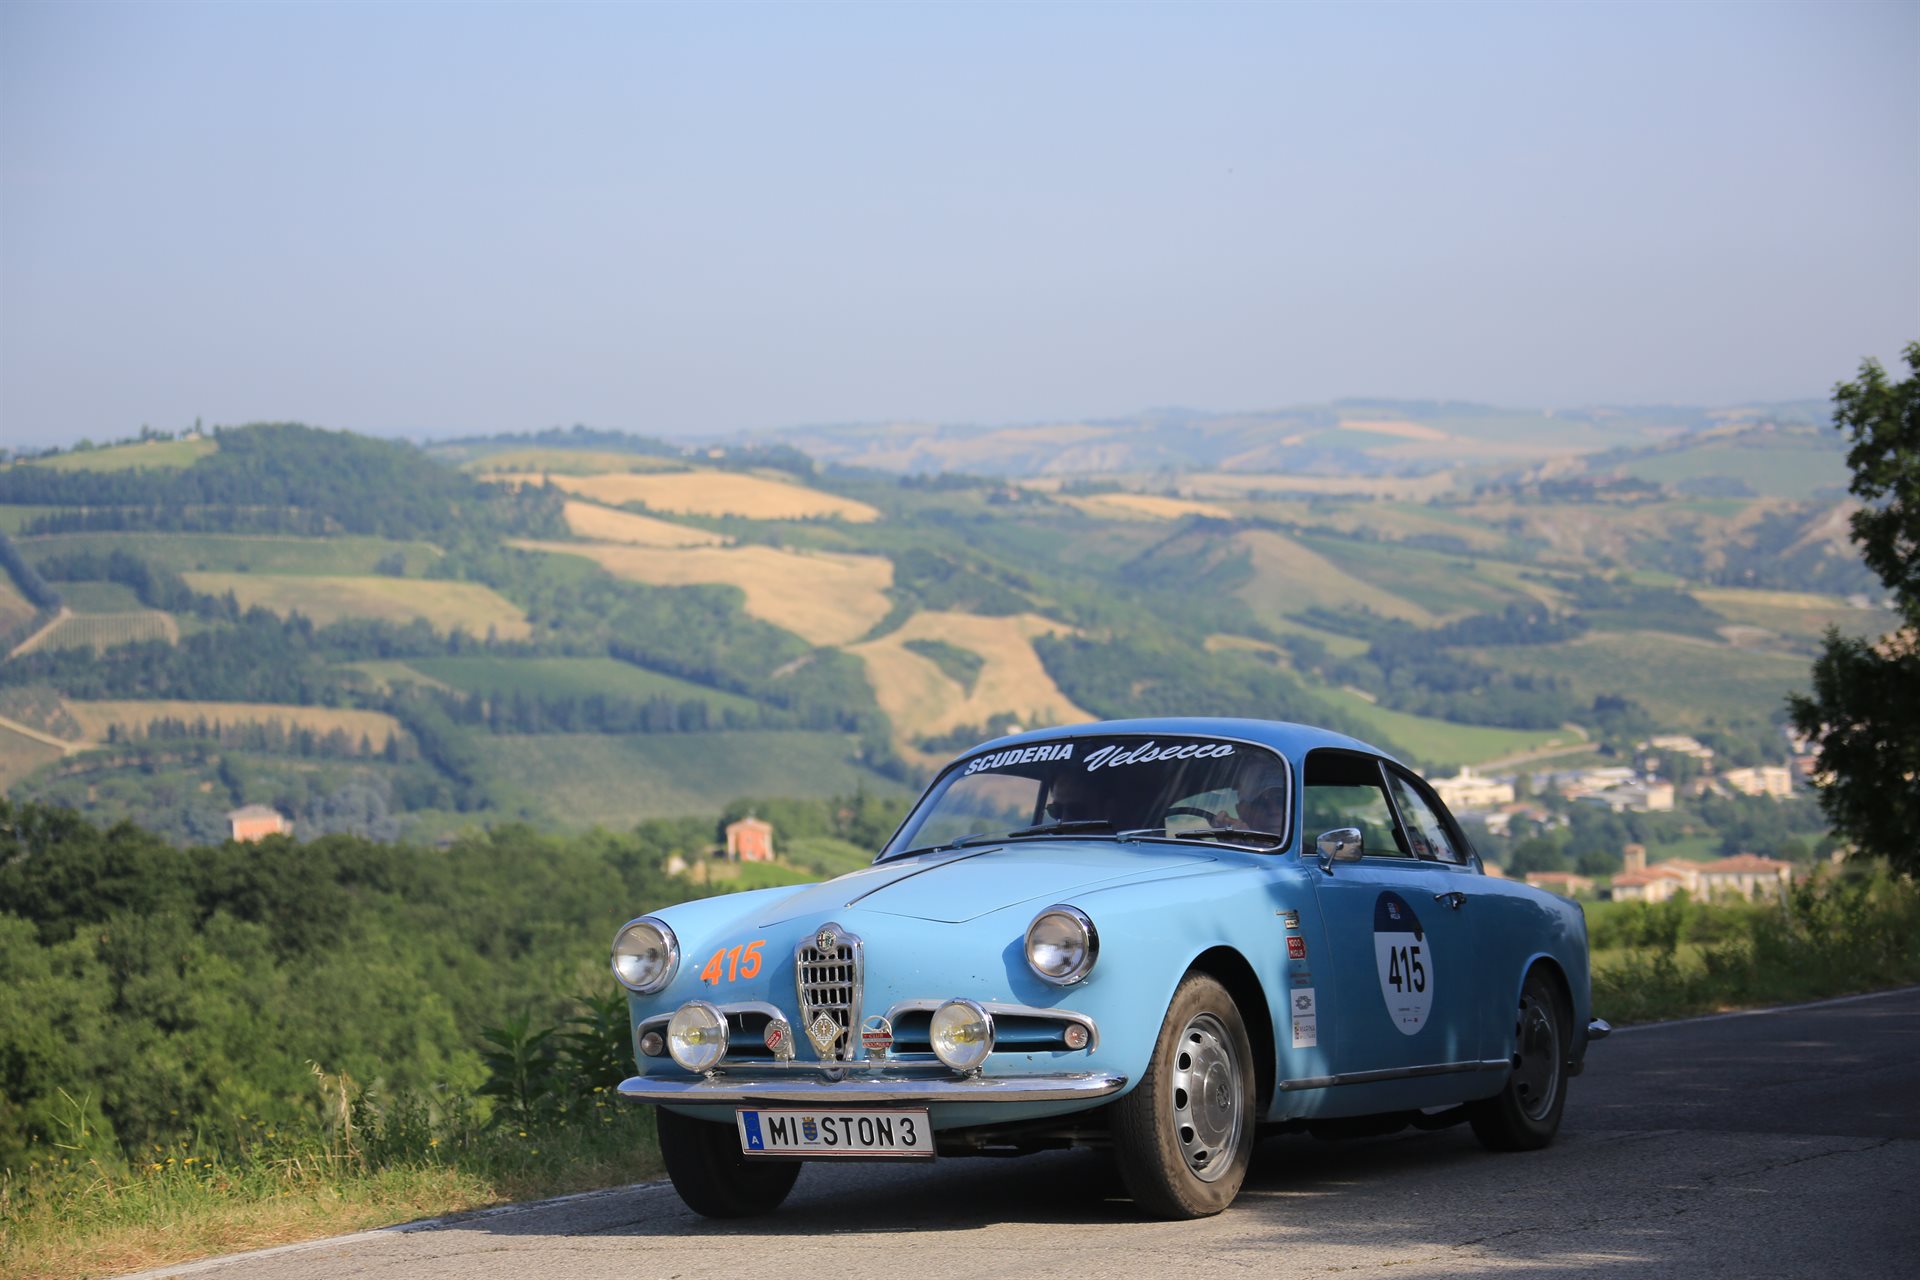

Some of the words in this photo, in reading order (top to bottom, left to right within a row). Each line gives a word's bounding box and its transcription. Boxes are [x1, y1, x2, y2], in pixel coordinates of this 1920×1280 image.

[964, 743, 1074, 776] SCUDERIA
[1083, 740, 1236, 772] Velsecco
[700, 939, 766, 985] 415
[1389, 946, 1425, 993] 415
[751, 1135, 760, 1145] A
[768, 1117, 799, 1146] MI
[821, 1117, 896, 1147] STON
[900, 1117, 917, 1147] 3
